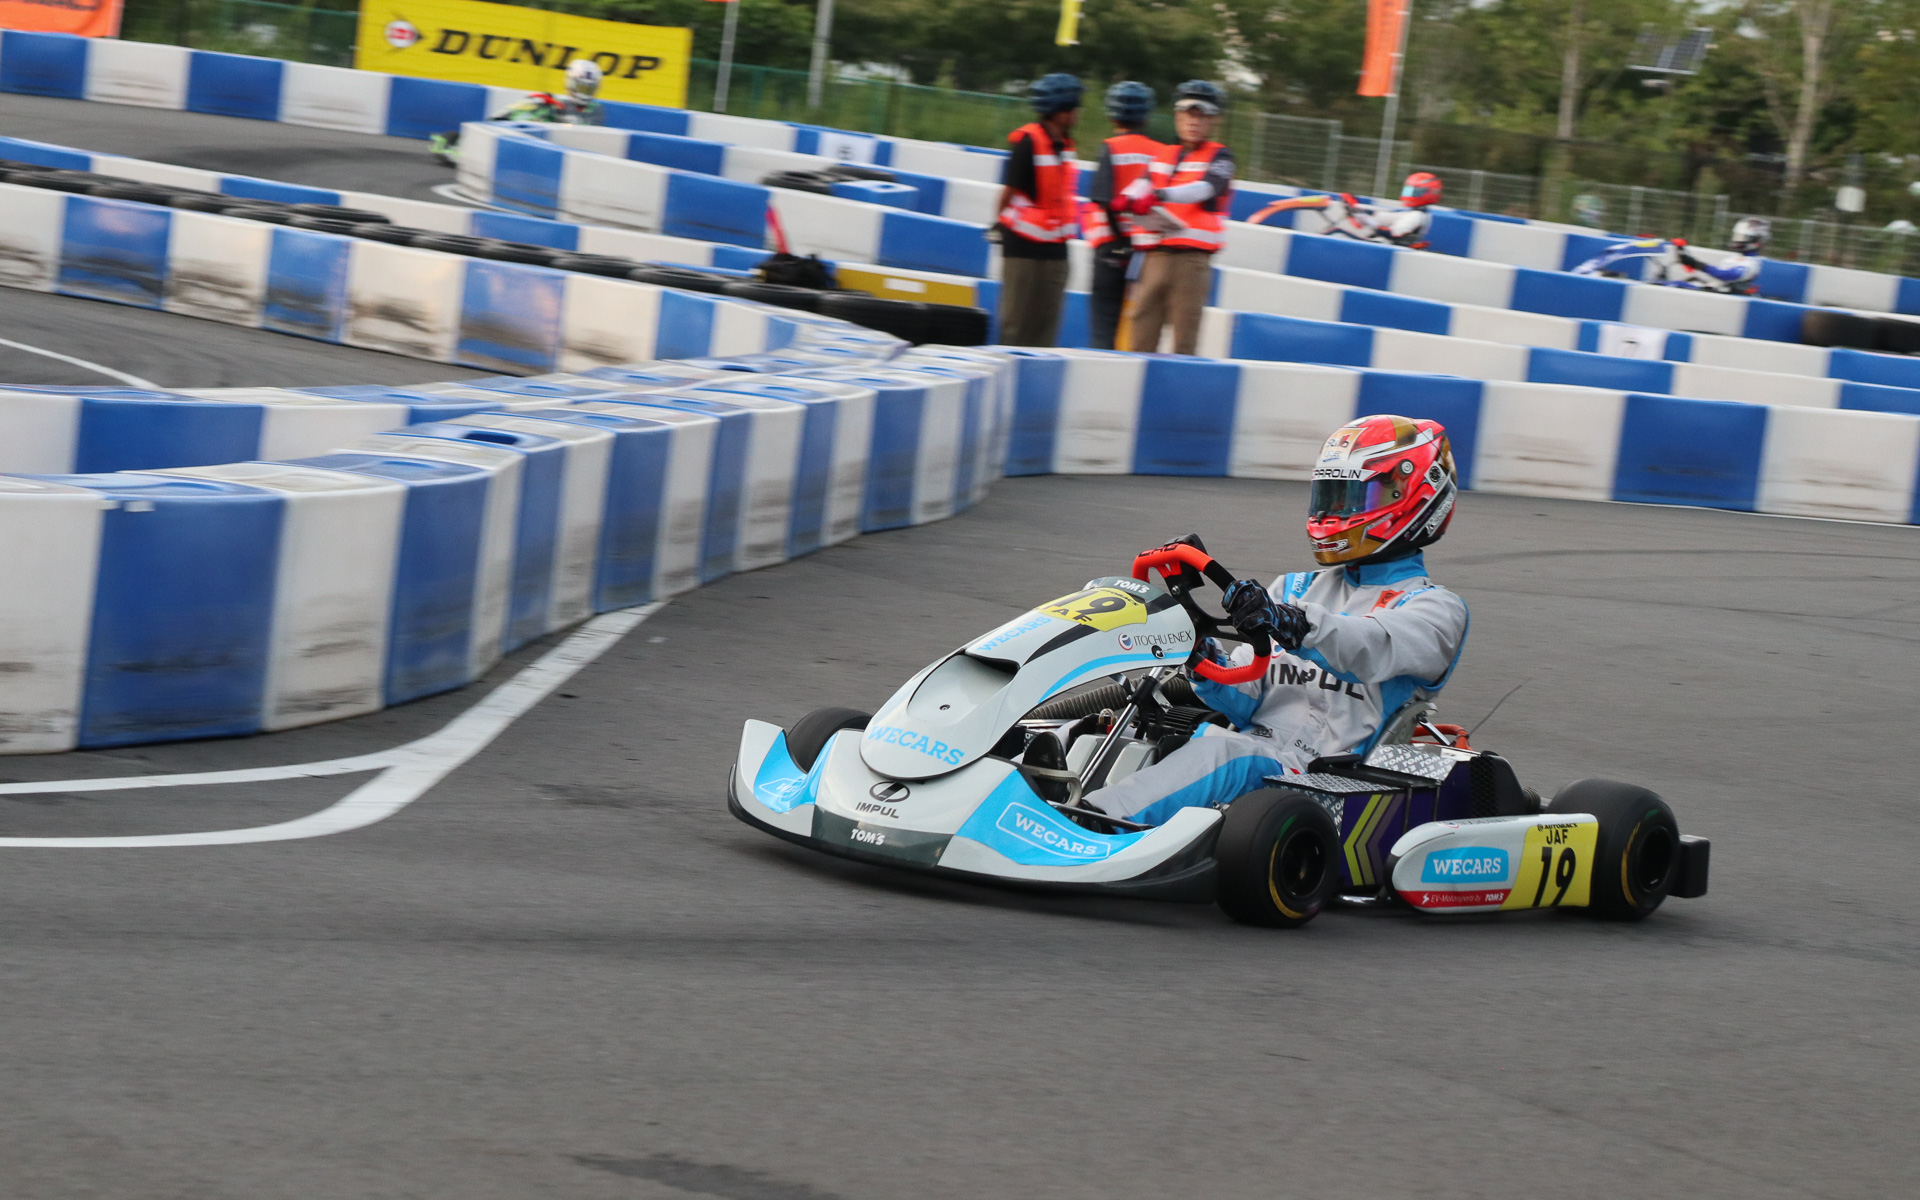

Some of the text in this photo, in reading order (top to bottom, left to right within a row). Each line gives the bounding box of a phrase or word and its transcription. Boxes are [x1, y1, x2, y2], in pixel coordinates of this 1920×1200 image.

[431, 28, 662, 80] DUNLOP
[1113, 579, 1150, 594] TOM'S
[977, 616, 1052, 652] WECARS
[1133, 630, 1192, 646] ITOCHU ENEX
[867, 725, 966, 766] WECARS
[855, 802, 900, 819] IMPUL
[851, 828, 884, 845] TOM'S
[1014, 812, 1098, 856] WECARS
[1546, 829, 1569, 845] JAF
[1433, 857, 1501, 876] WECARS
[1531, 846, 1576, 908] 19
